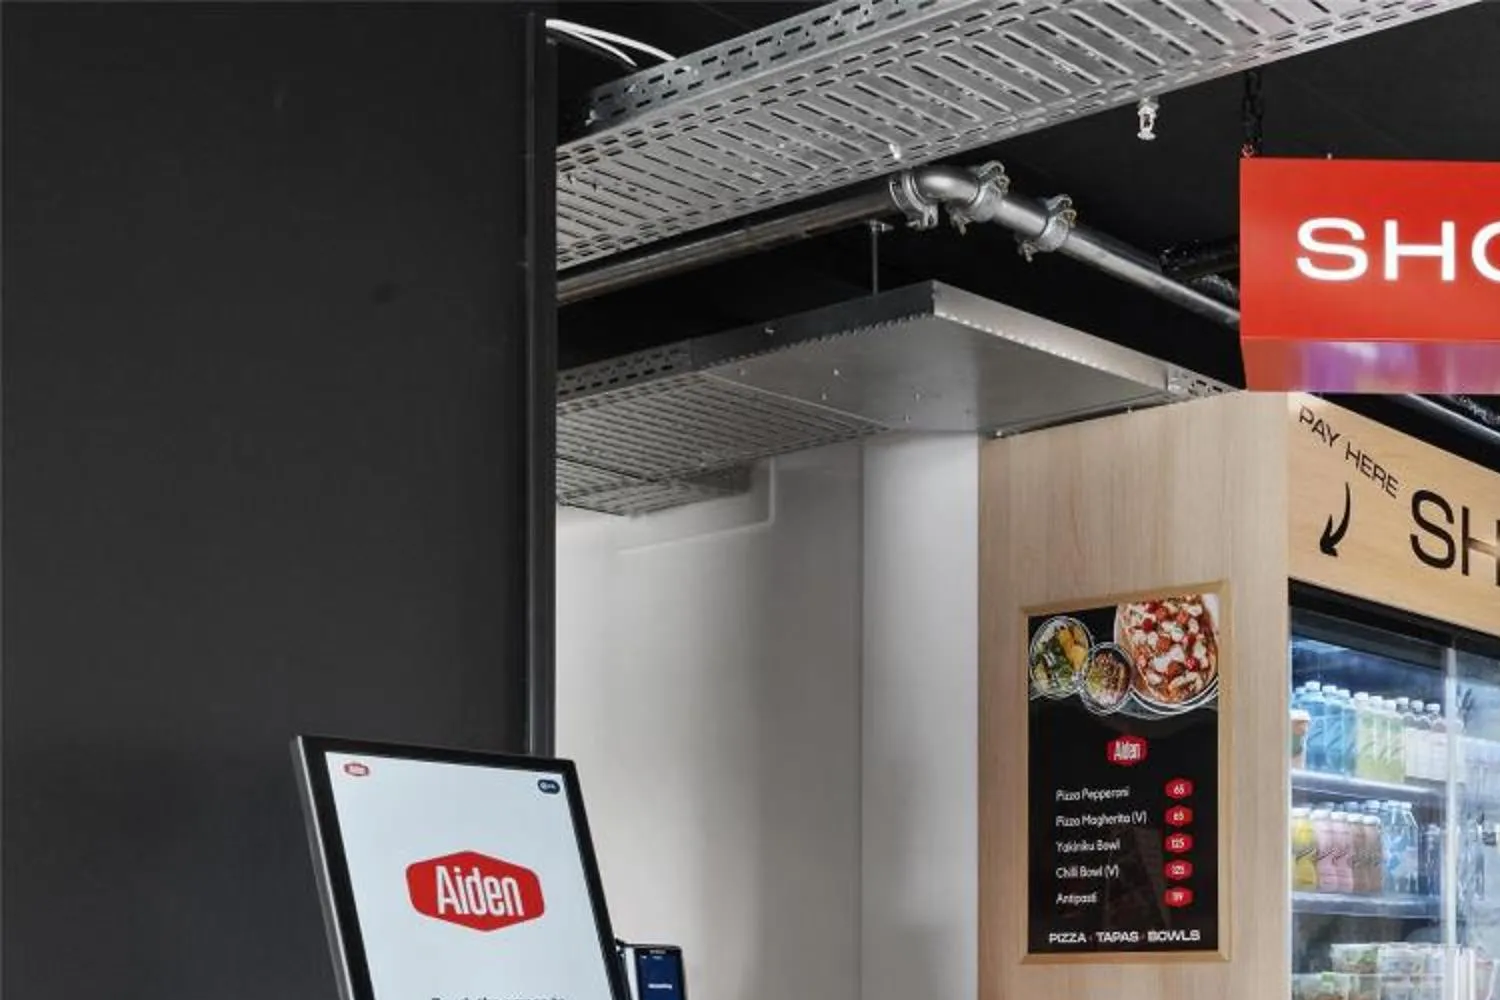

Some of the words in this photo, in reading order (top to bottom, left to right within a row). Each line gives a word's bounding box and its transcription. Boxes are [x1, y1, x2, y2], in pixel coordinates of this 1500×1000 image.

[1299, 405, 1341, 448] PAY
[1345, 440, 1400, 500] HERE
[1082, 786, 1130, 803] Pepperoni
[1132, 810, 1148, 825] (V)
[1096, 838, 1121, 851] Bowl
[1080, 865, 1103, 878] Bowl
[1104, 863, 1120, 879] (V)
[435, 865, 525, 917] Aiden
[1049, 931, 1087, 944] PIZZA
[1095, 931, 1139, 943] TAPAS
[1147, 929, 1200, 942] BOWLS
